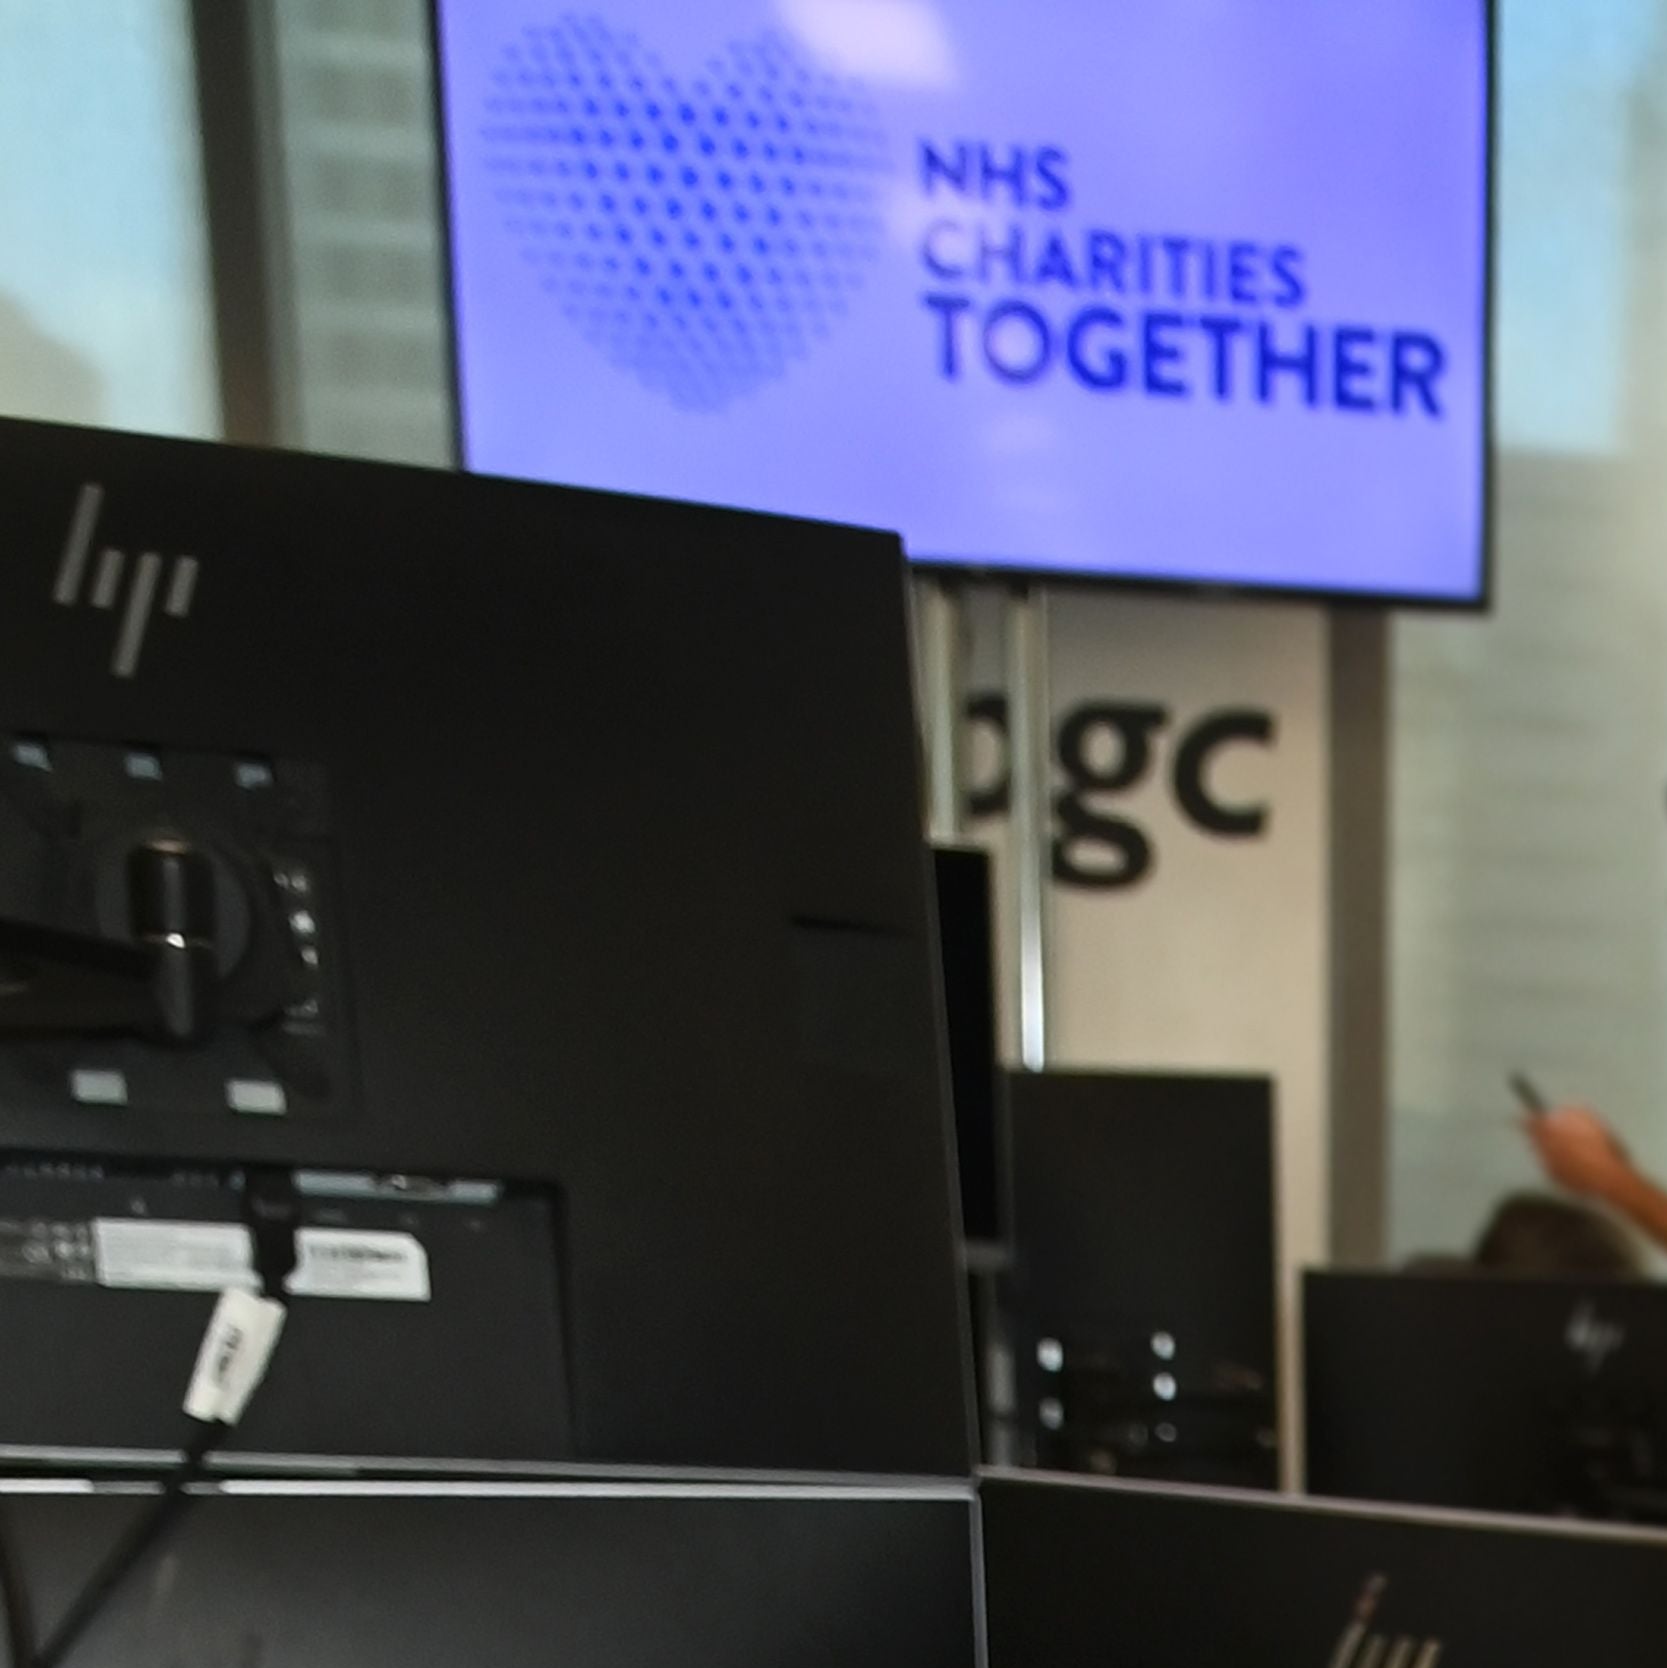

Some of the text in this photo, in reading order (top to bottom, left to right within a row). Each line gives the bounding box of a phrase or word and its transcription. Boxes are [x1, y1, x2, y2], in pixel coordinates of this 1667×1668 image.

[915, 138, 1071, 209] NHS
[919, 219, 1308, 309] CHARITIES
[919, 291, 1447, 420] TOGETHER
